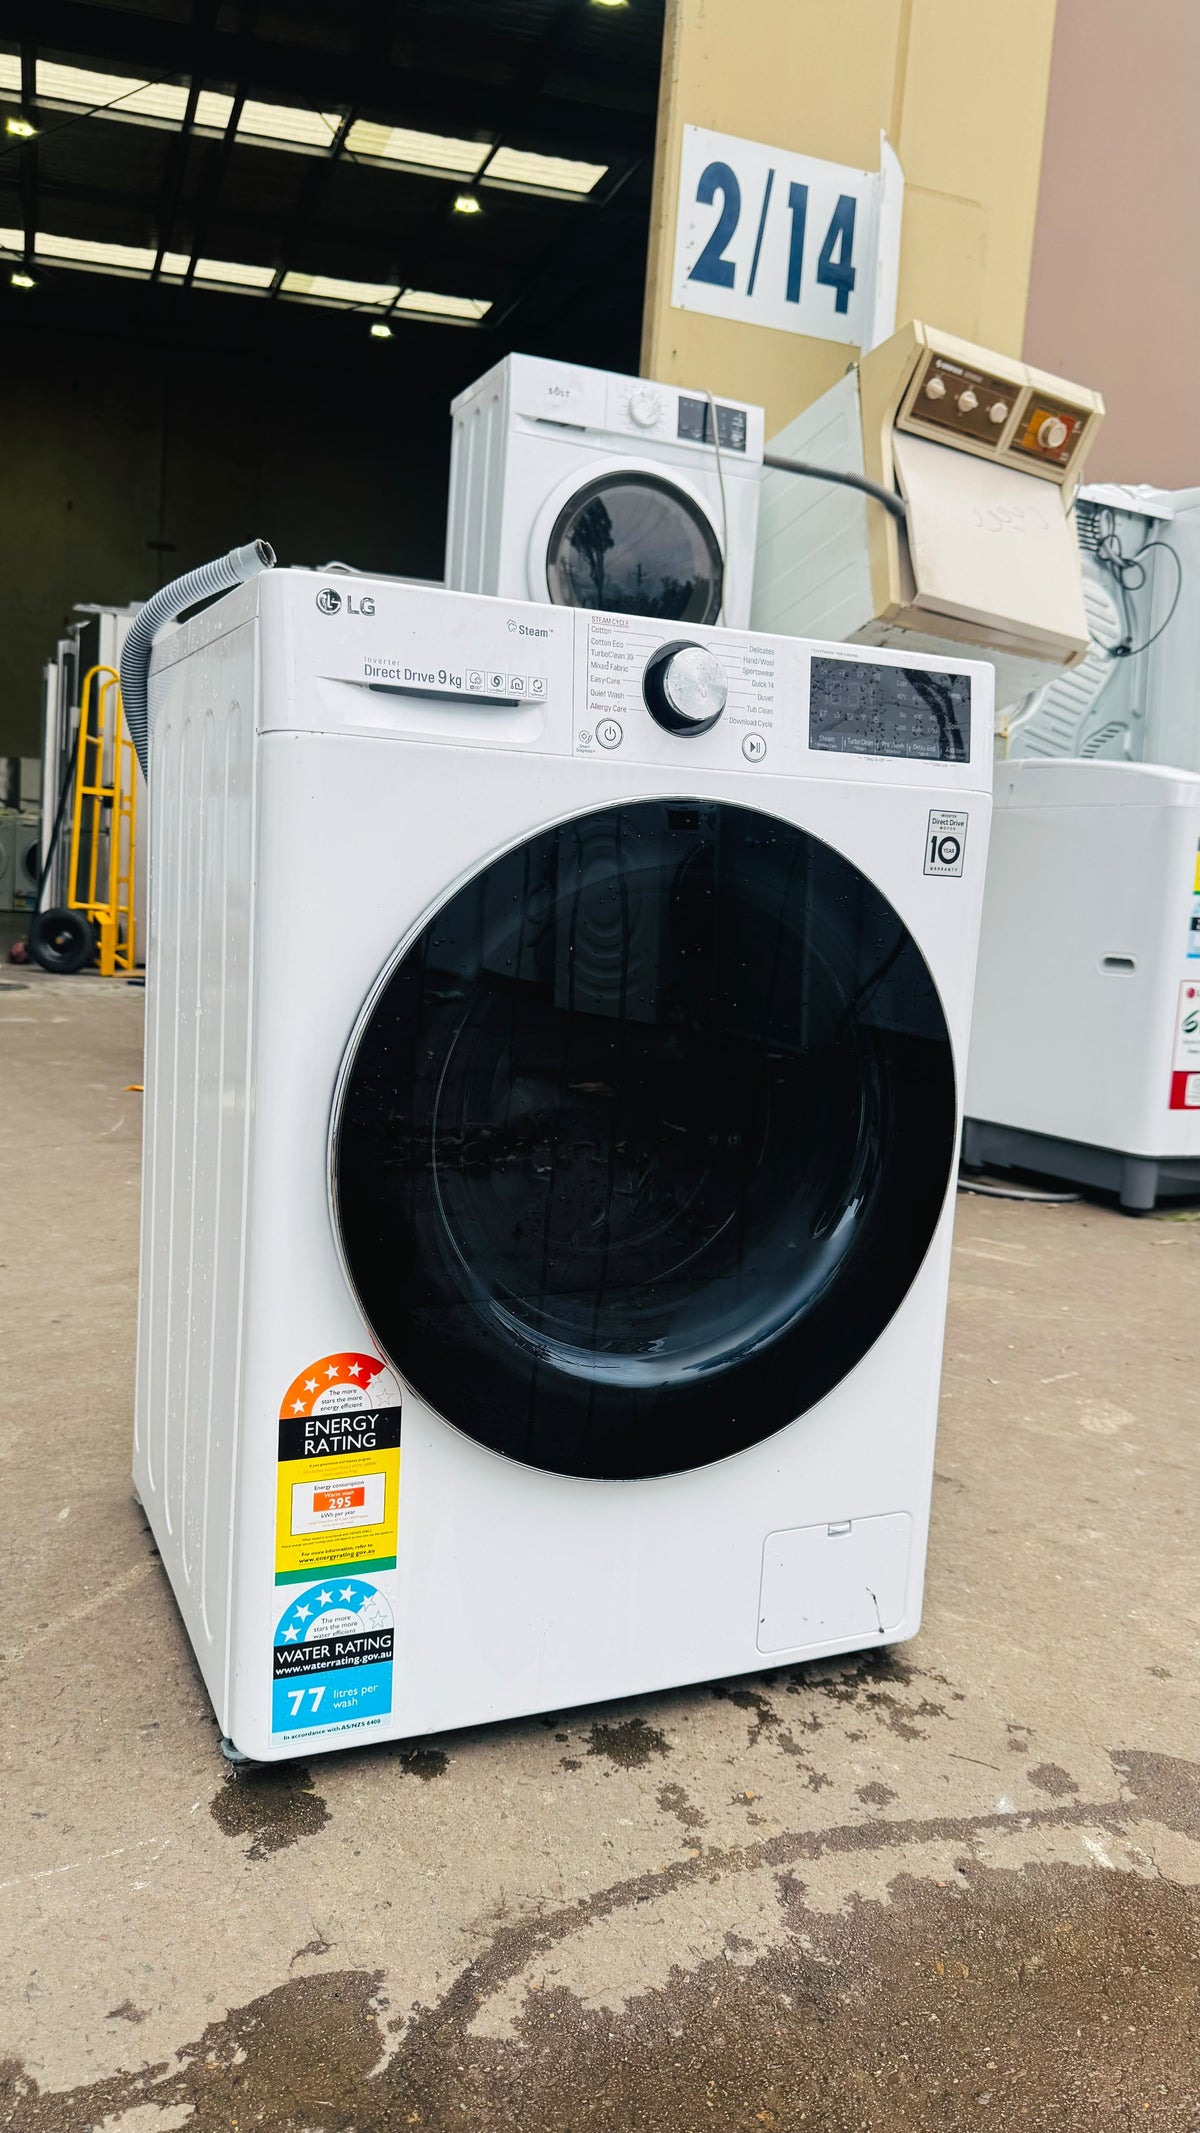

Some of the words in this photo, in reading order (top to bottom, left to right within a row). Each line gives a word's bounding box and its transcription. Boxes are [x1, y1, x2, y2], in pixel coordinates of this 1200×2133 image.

[687, 161, 857, 315] 2/14
[347, 595, 376, 616] LG
[591, 625, 612, 635] Cotton
[590, 637, 612, 647] Cotton
[612, 640, 624, 649] Eco
[749, 645, 775, 656] Delicates
[364, 656, 400, 667] Inverter
[590, 661, 610, 671] Mixed
[609, 663, 629, 673] Fabric
[743, 656, 775, 666] Hand/Wool
[364, 664, 401, 680] Direct
[404, 668, 435, 683] Drive
[438, 669, 447, 685] 9
[449, 673, 462, 689] kg
[742, 667, 775, 678] Sportswear
[751, 680, 767, 689] Quick
[768, 681, 775, 689] 14
[590, 688, 607, 698] Quiet
[607, 690, 625, 699] Wash
[757, 693, 774, 703] Duvet
[590, 702, 612, 713] Allergy
[612, 704, 627, 713] Care
[746, 705, 757, 714] Tub
[758, 707, 774, 715] Clean
[729, 717, 757, 727] Download
[757, 719, 774, 728] Cycle
[932, 818, 949, 826] Direct
[949, 819, 964, 827] Drive
[930, 836, 960, 865] 10
[340, 1402, 363, 1410] efficient
[305, 1414, 379, 1437] ENERGY
[304, 1432, 377, 1455] RATING
[332, 1480, 365, 1488] consumption
[328, 1496, 352, 1510] 295
[298, 1549, 376, 1563] www.energyrating.gov.au
[332, 1628, 356, 1637] efficient
[276, 1645, 330, 1664] WATER
[335, 1635, 392, 1656] RATING
[275, 1650, 392, 1676] www.waterrating.gov.au
[333, 1687, 358, 1699] litres
[361, 1684, 379, 1697] per
[287, 1685, 327, 1717] 77
[333, 1698, 358, 1710] wash
[291, 1729, 326, 1740] accordance
[366, 1718, 381, 1726] 6400
